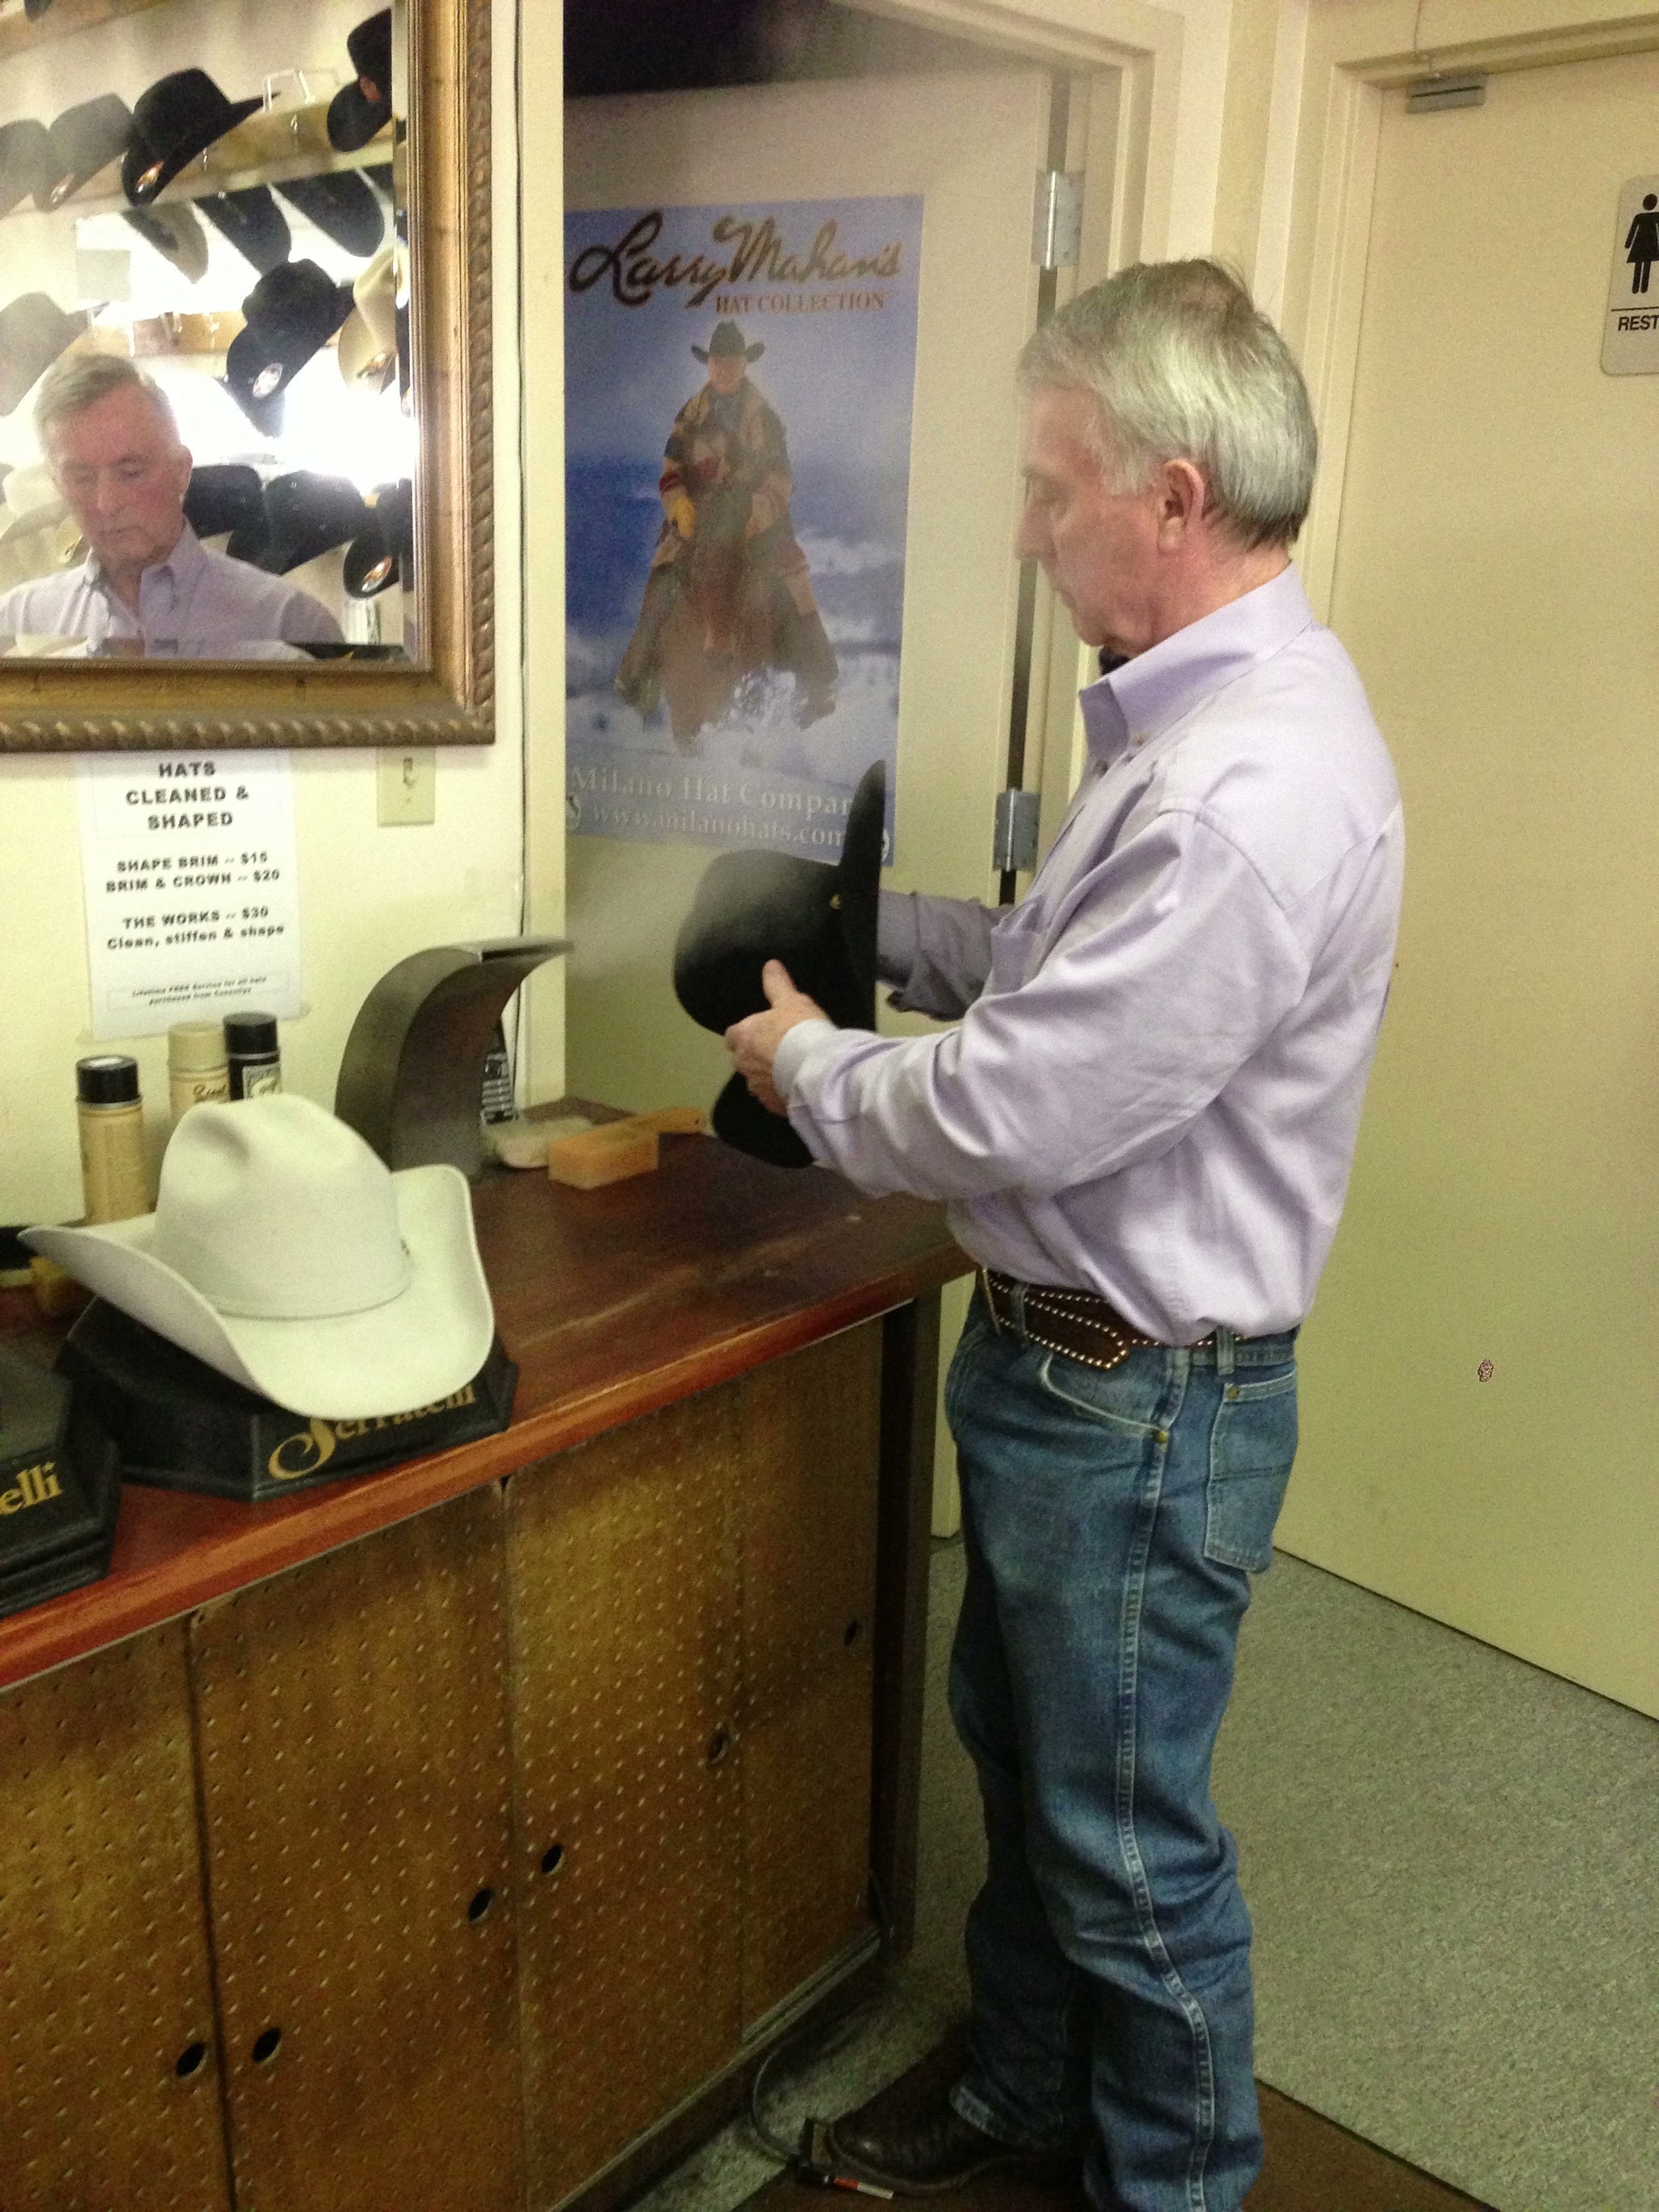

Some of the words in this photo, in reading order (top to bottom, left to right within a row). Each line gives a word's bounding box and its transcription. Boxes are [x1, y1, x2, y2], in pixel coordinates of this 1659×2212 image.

[569, 211, 729, 309] Larry
[713, 215, 902, 283] Mahan's
[715, 295, 752, 314] HAT
[757, 292, 890, 313] COLLECTION
[1617, 314, 1659, 332] REST
[158, 761, 216, 778] HATS
[126, 786, 226, 805] CLEANED
[236, 785, 249, 799] &
[572, 766, 672, 798] Milano
[684, 776, 730, 804] Hat
[147, 812, 233, 830] SHAPED
[117, 857, 172, 872] SHAPE
[177, 855, 219, 869] BRIM
[241, 851, 268, 865] $15
[106, 878, 148, 893] BRIM
[156, 876, 166, 889] &
[173, 872, 232, 888] CROWN
[253, 869, 280, 883] $20
[122, 915, 155, 930] THE
[162, 910, 220, 926] WORKS
[242, 906, 269, 920] $30
[107, 936, 160, 950] Clean,
[164, 931, 217, 946] stiffen
[224, 928, 233, 940] &
